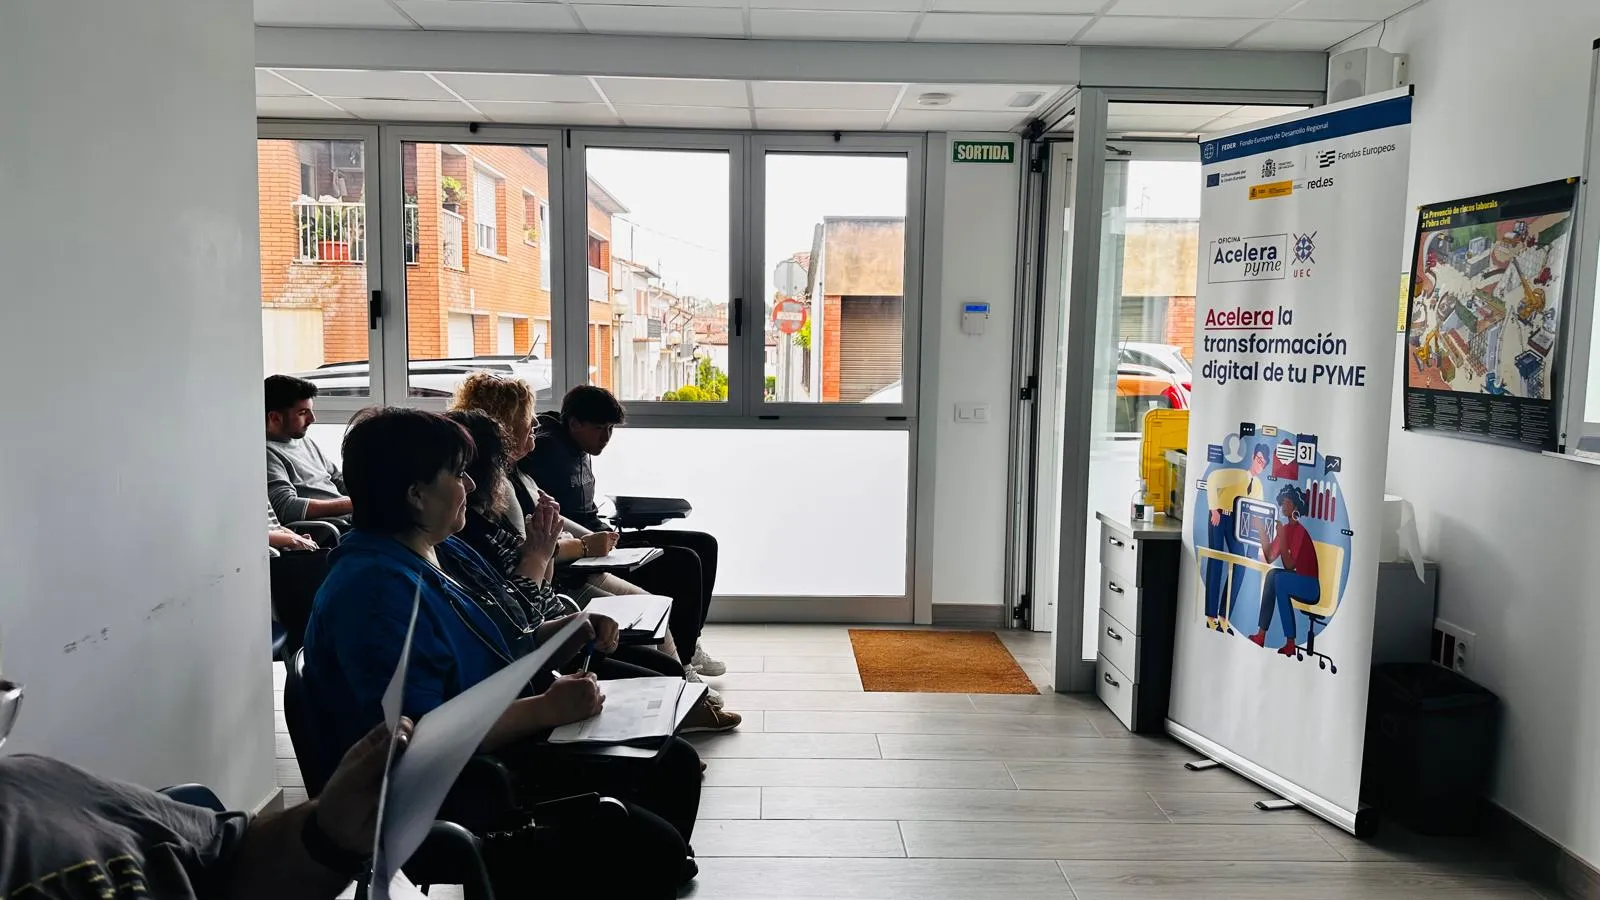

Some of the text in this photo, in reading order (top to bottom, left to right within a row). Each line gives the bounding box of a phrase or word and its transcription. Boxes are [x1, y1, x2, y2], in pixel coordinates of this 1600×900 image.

[1221, 142, 1237, 151] FEDER
[1239, 137, 1254, 147] Fondo
[1254, 134, 1273, 145] Europeo
[1281, 127, 1306, 138] Desarrollo
[1306, 122, 1329, 133] Regional
[957, 144, 1010, 160] SORTIDA
[1338, 143, 1396, 160] Fondos Europeos
[1307, 177, 1334, 190] red.es
[1217, 236, 1241, 244] OFICINA
[1213, 242, 1277, 264] Acelera
[1243, 260, 1282, 277] pyme
[1205, 305, 1293, 326] Acelera la
[1204, 332, 1347, 355] transformación
[1202, 360, 1366, 386] digital de tu PYME
[1300, 446, 1312, 460] 31
